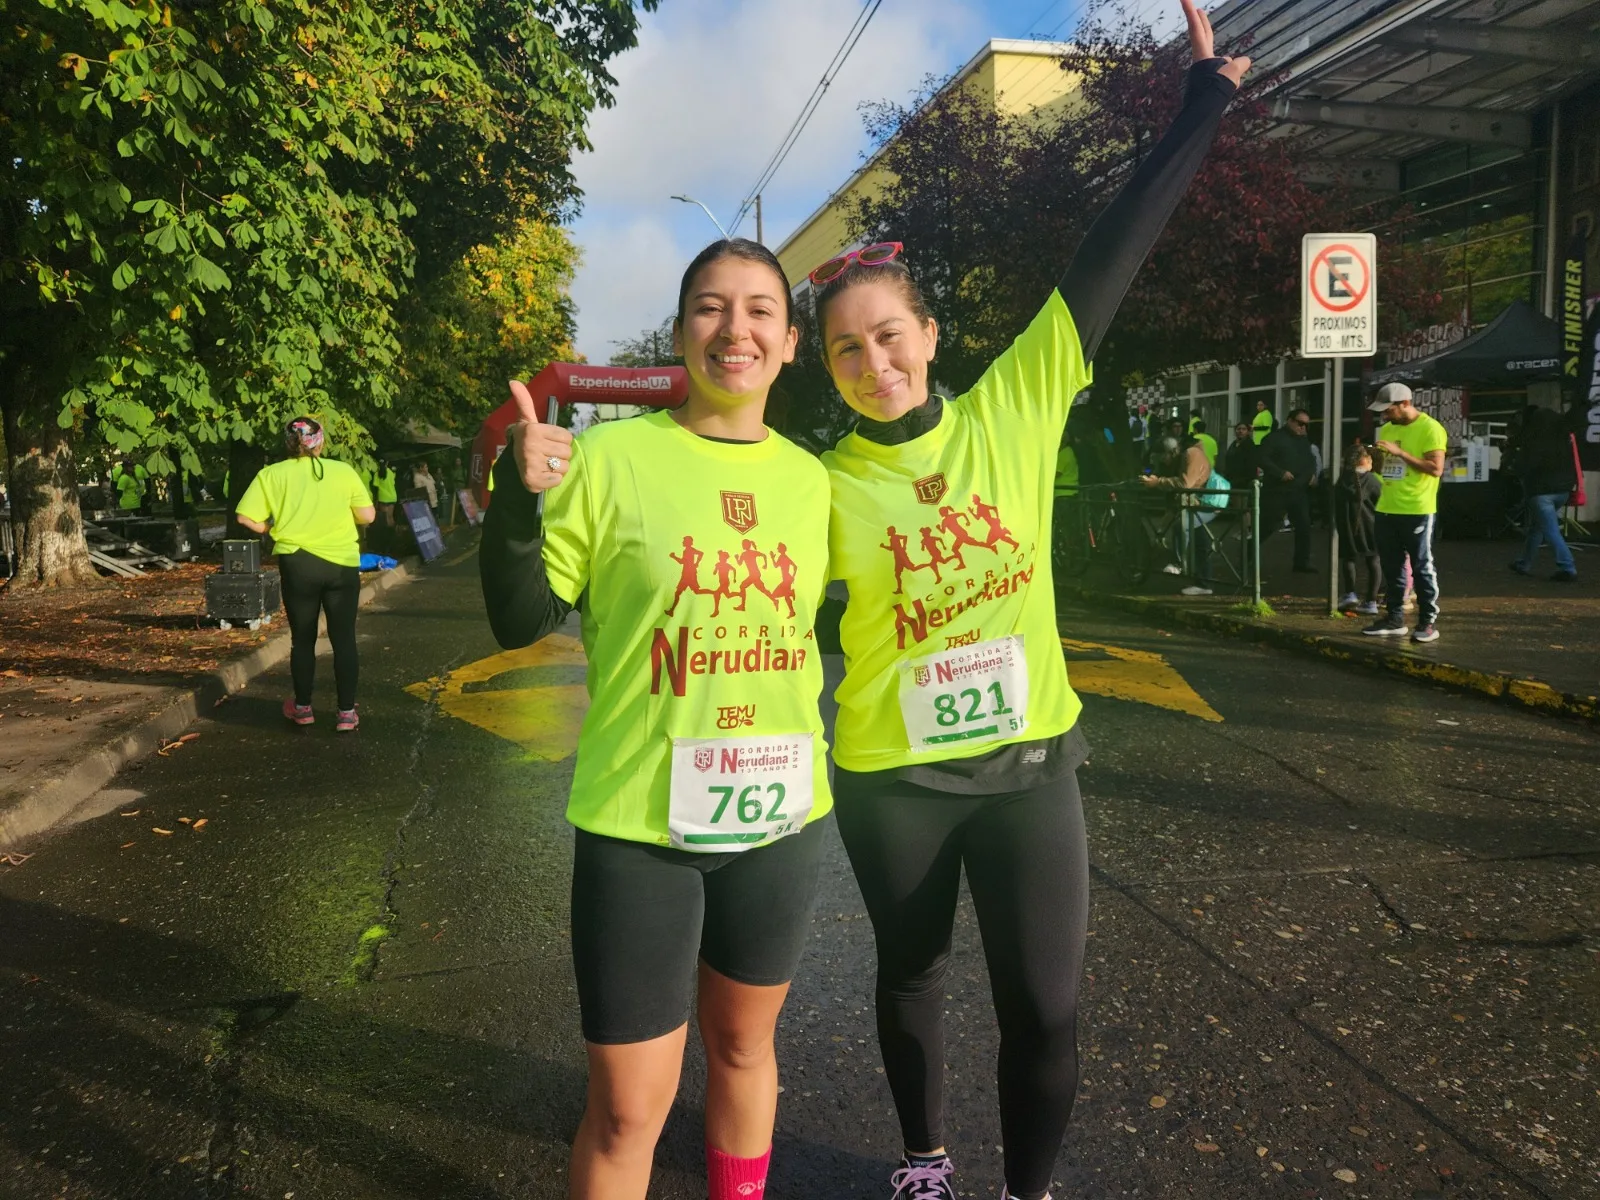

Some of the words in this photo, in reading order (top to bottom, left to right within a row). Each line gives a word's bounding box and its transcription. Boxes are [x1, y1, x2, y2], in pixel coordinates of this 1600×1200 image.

[1564, 259, 1583, 352] FINISHER
[1312, 316, 1367, 330] PROXIMOS
[1313, 335, 1332, 348] 100
[1506, 358, 1559, 371] @racer
[926, 542, 1036, 602] CORRIDA
[693, 625, 813, 640] CORRIDA
[951, 647, 1000, 664] CORRIDA
[934, 656, 1003, 684] Nerudiana
[716, 704, 756, 720] TEMU
[934, 681, 1013, 727] 821
[739, 744, 788, 755] CORRIDA
[720, 747, 788, 774] Nerudiana
[708, 782, 788, 823] 762
